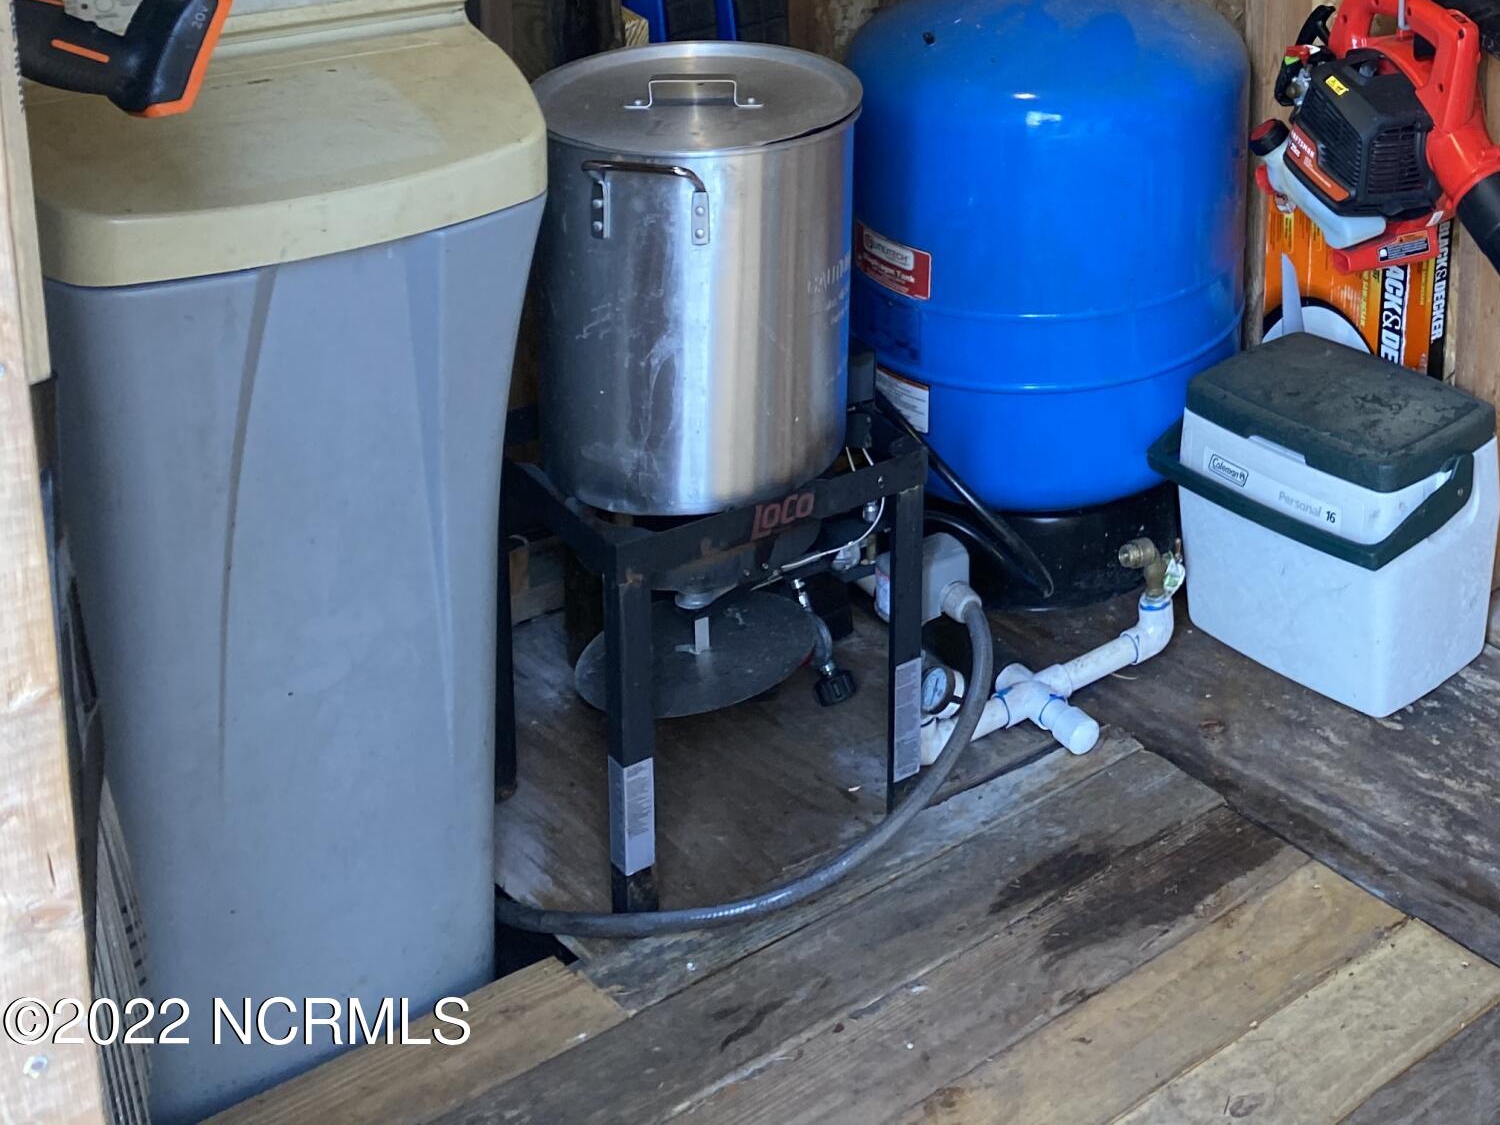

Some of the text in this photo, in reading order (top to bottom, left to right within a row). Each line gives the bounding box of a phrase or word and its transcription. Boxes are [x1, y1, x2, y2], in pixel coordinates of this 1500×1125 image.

[191, 5, 208, 29] 20V
[1211, 457, 1240, 479] Coleman
[1279, 490, 1337, 524] Personal 16
